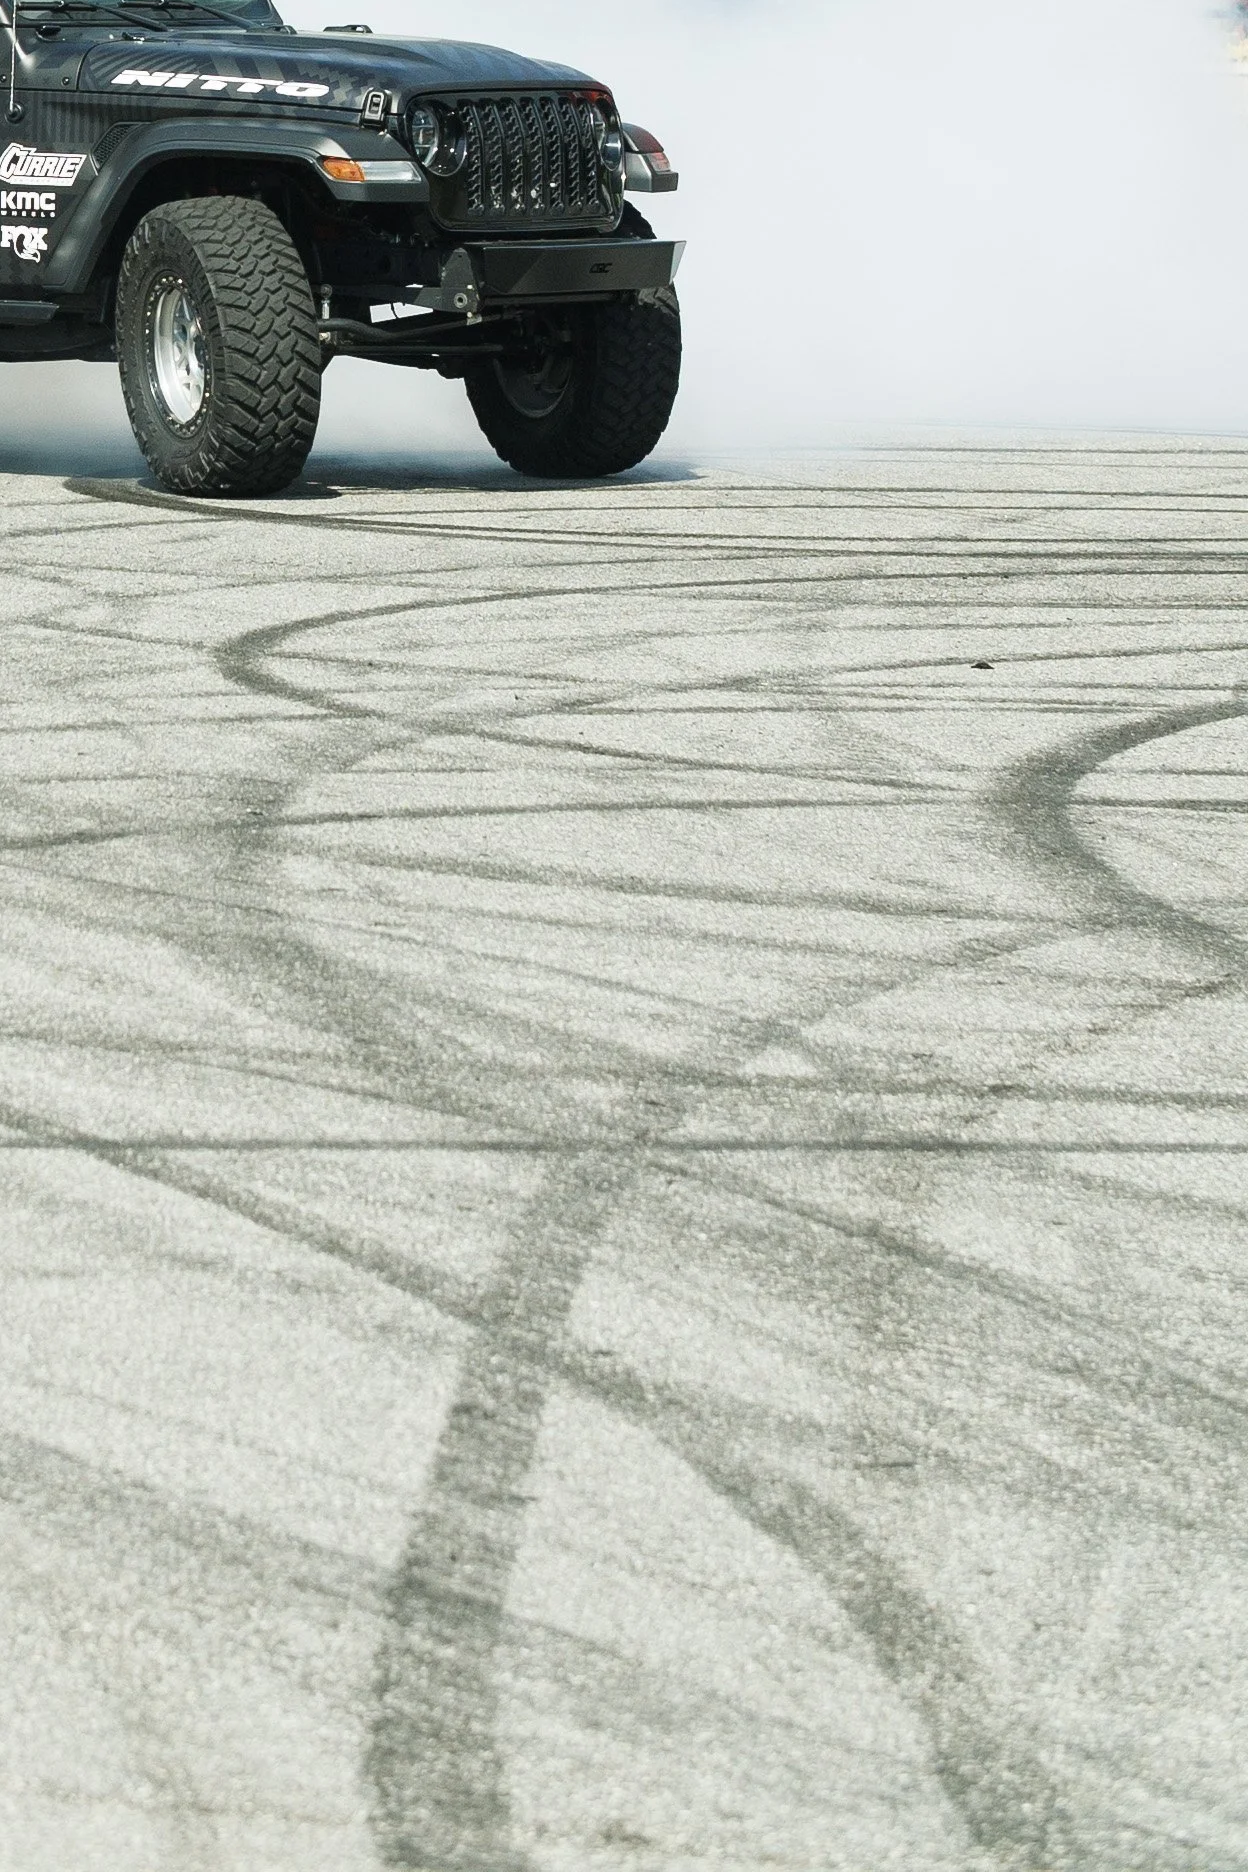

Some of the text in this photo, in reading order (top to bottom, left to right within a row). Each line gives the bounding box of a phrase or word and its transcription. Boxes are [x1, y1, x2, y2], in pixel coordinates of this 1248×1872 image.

[110, 69, 330, 97] NITTO
[0, 190, 56, 211] KMC
[0, 225, 48, 261] FOX
